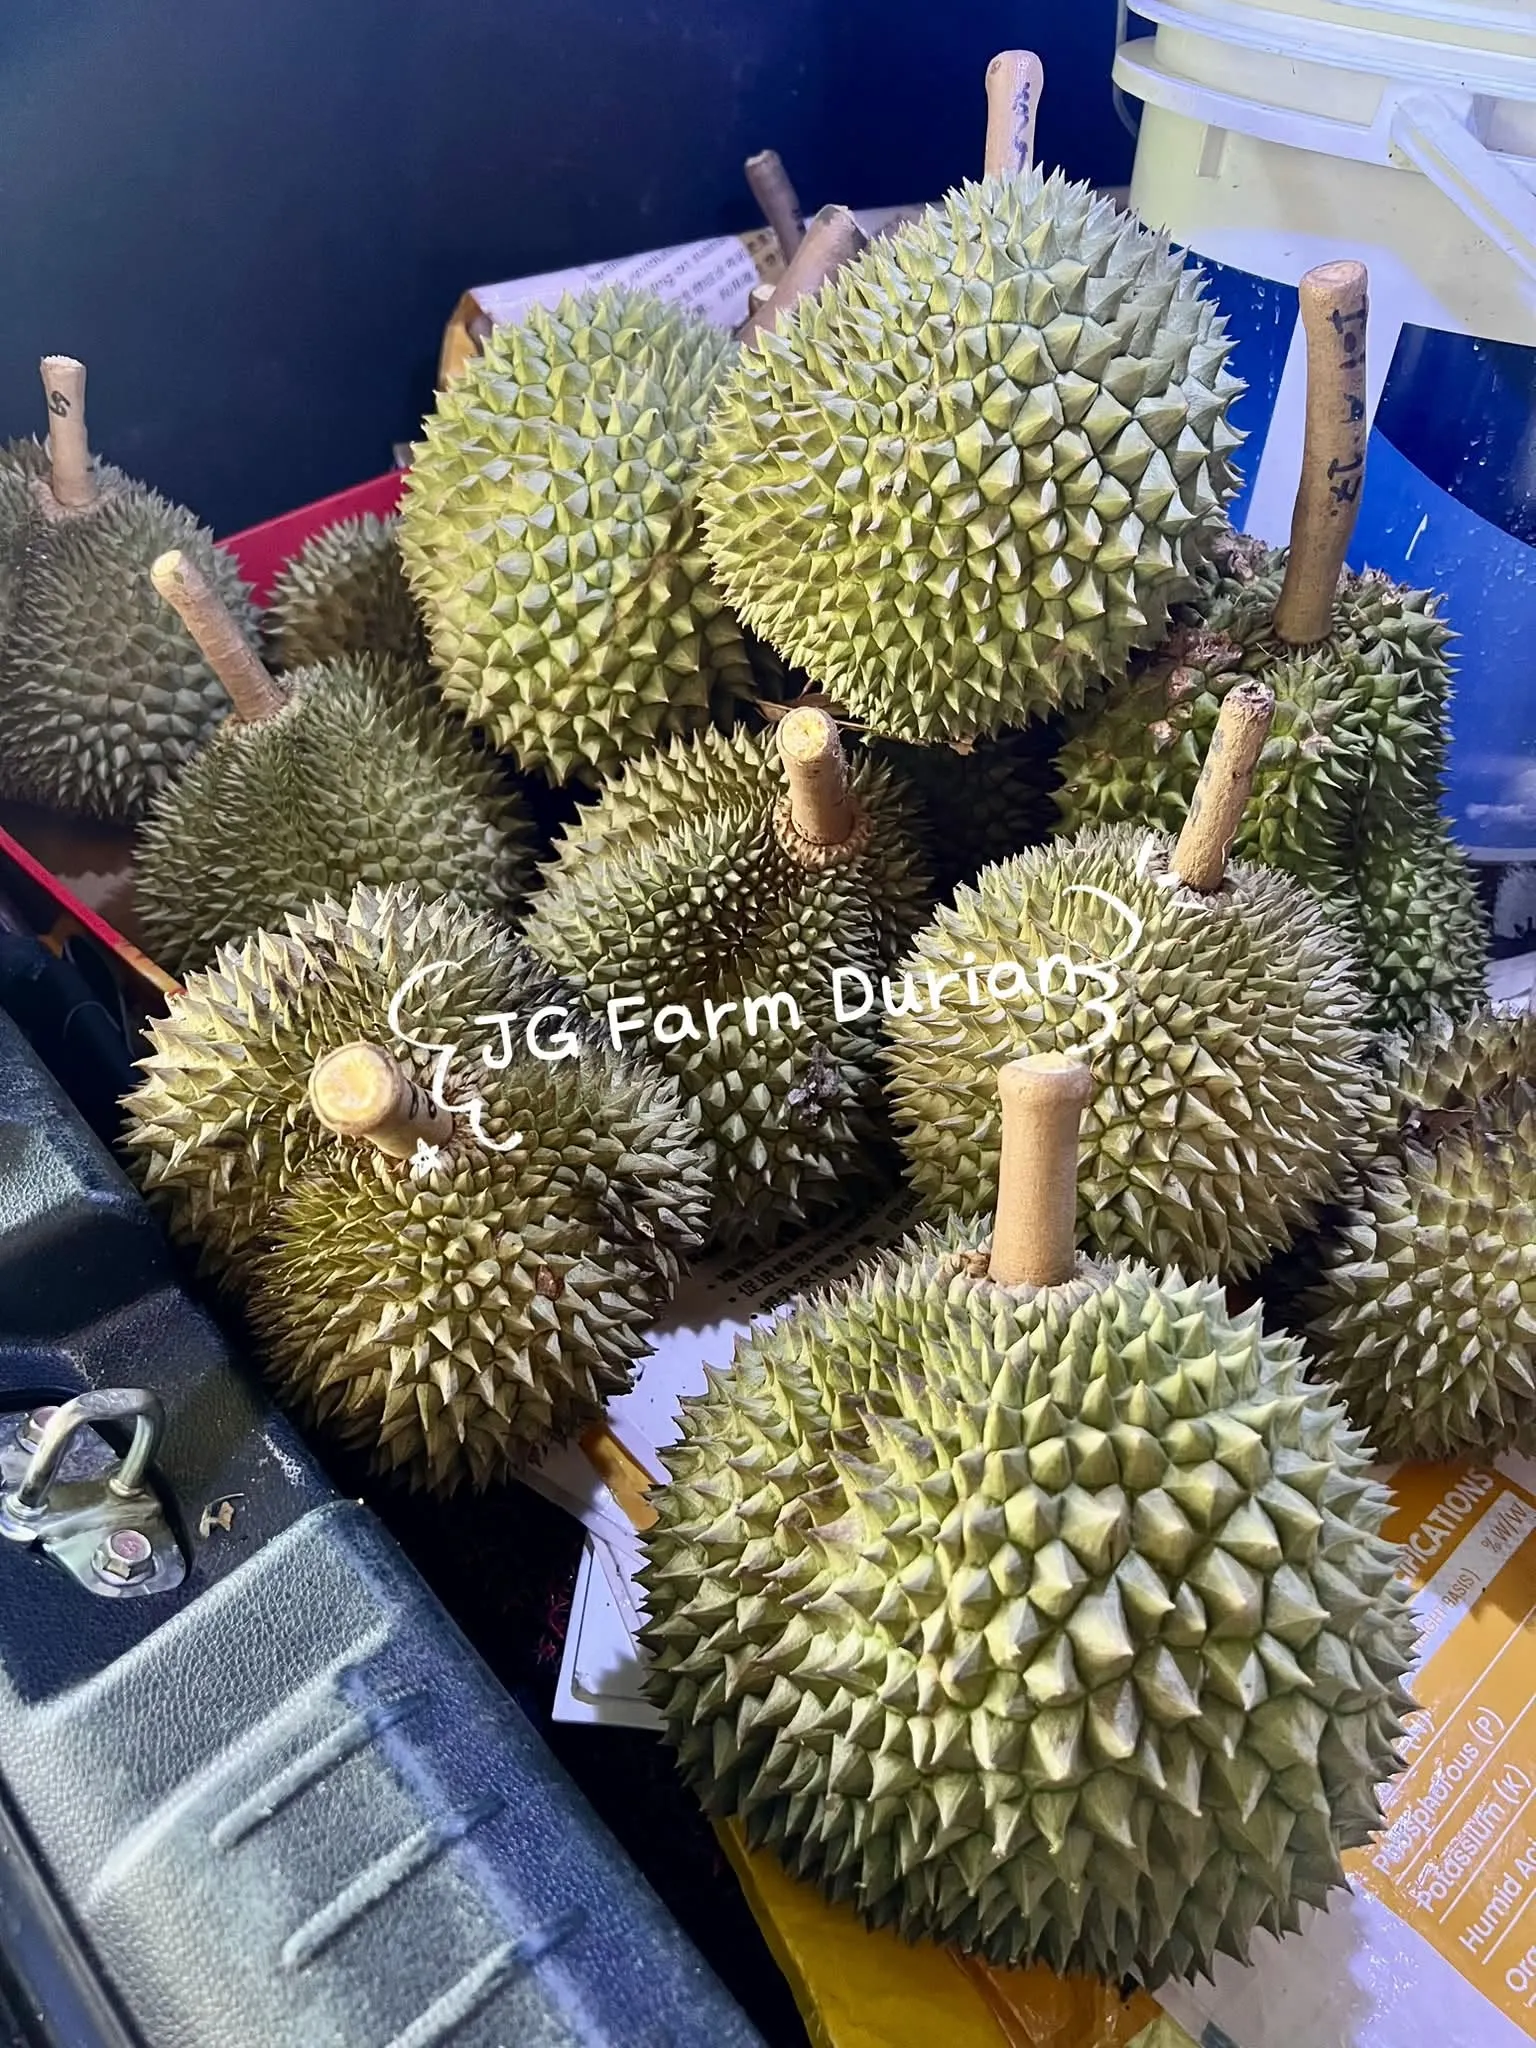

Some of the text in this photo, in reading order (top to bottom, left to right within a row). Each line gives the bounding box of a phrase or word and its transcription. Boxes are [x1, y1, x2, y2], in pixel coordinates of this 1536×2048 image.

[1371, 1741, 1481, 1876] Phosphorous
[1466, 1705, 1506, 1746] (P)
[1415, 1762, 1532, 1914] Potassium (K)
[1457, 1870, 1523, 1954] Humid
